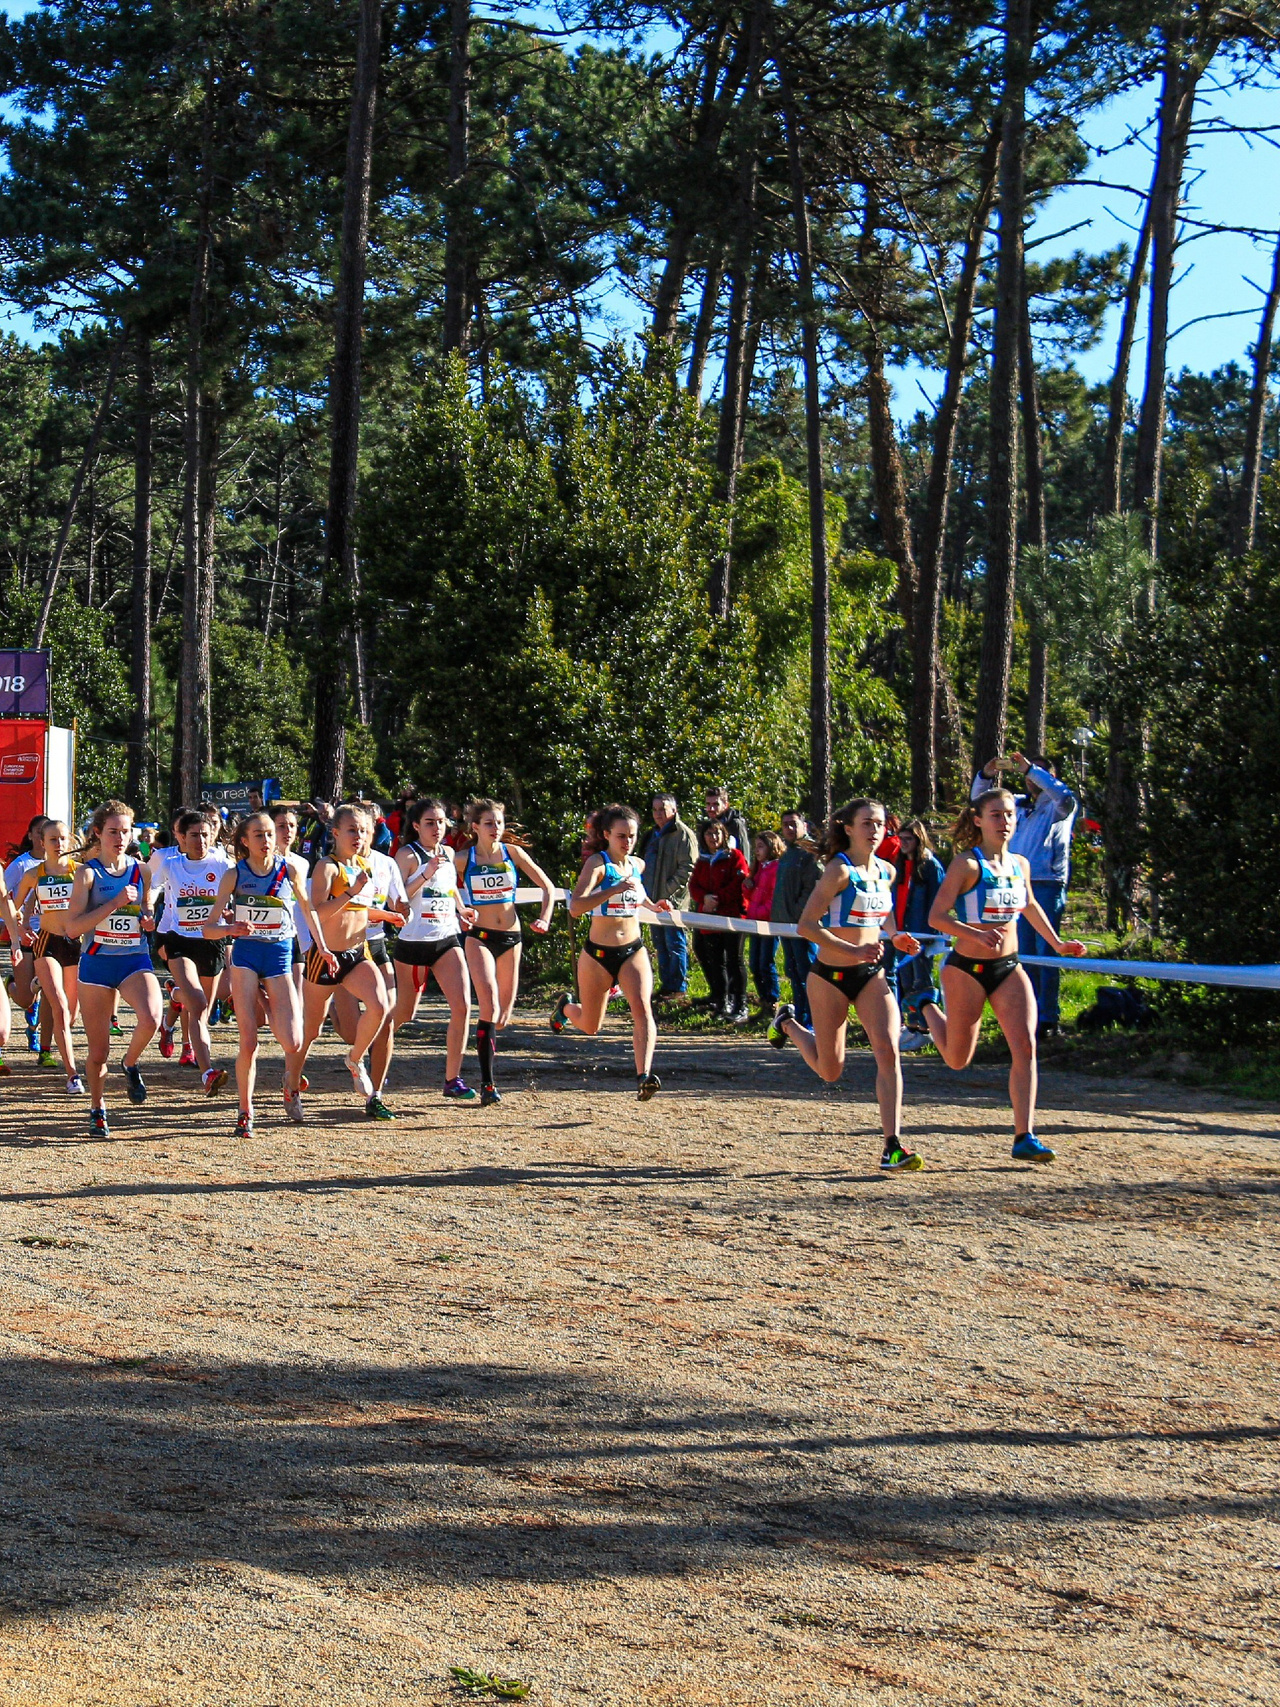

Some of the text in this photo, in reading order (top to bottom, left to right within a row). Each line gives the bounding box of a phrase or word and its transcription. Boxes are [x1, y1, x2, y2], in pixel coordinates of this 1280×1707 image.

[481, 875, 505, 888] 102
[48, 886, 68, 897] 145
[179, 885, 216, 897] sölen
[186, 908, 209, 919] 252
[247, 909, 270, 922] 177
[109, 918, 130, 931] 165
